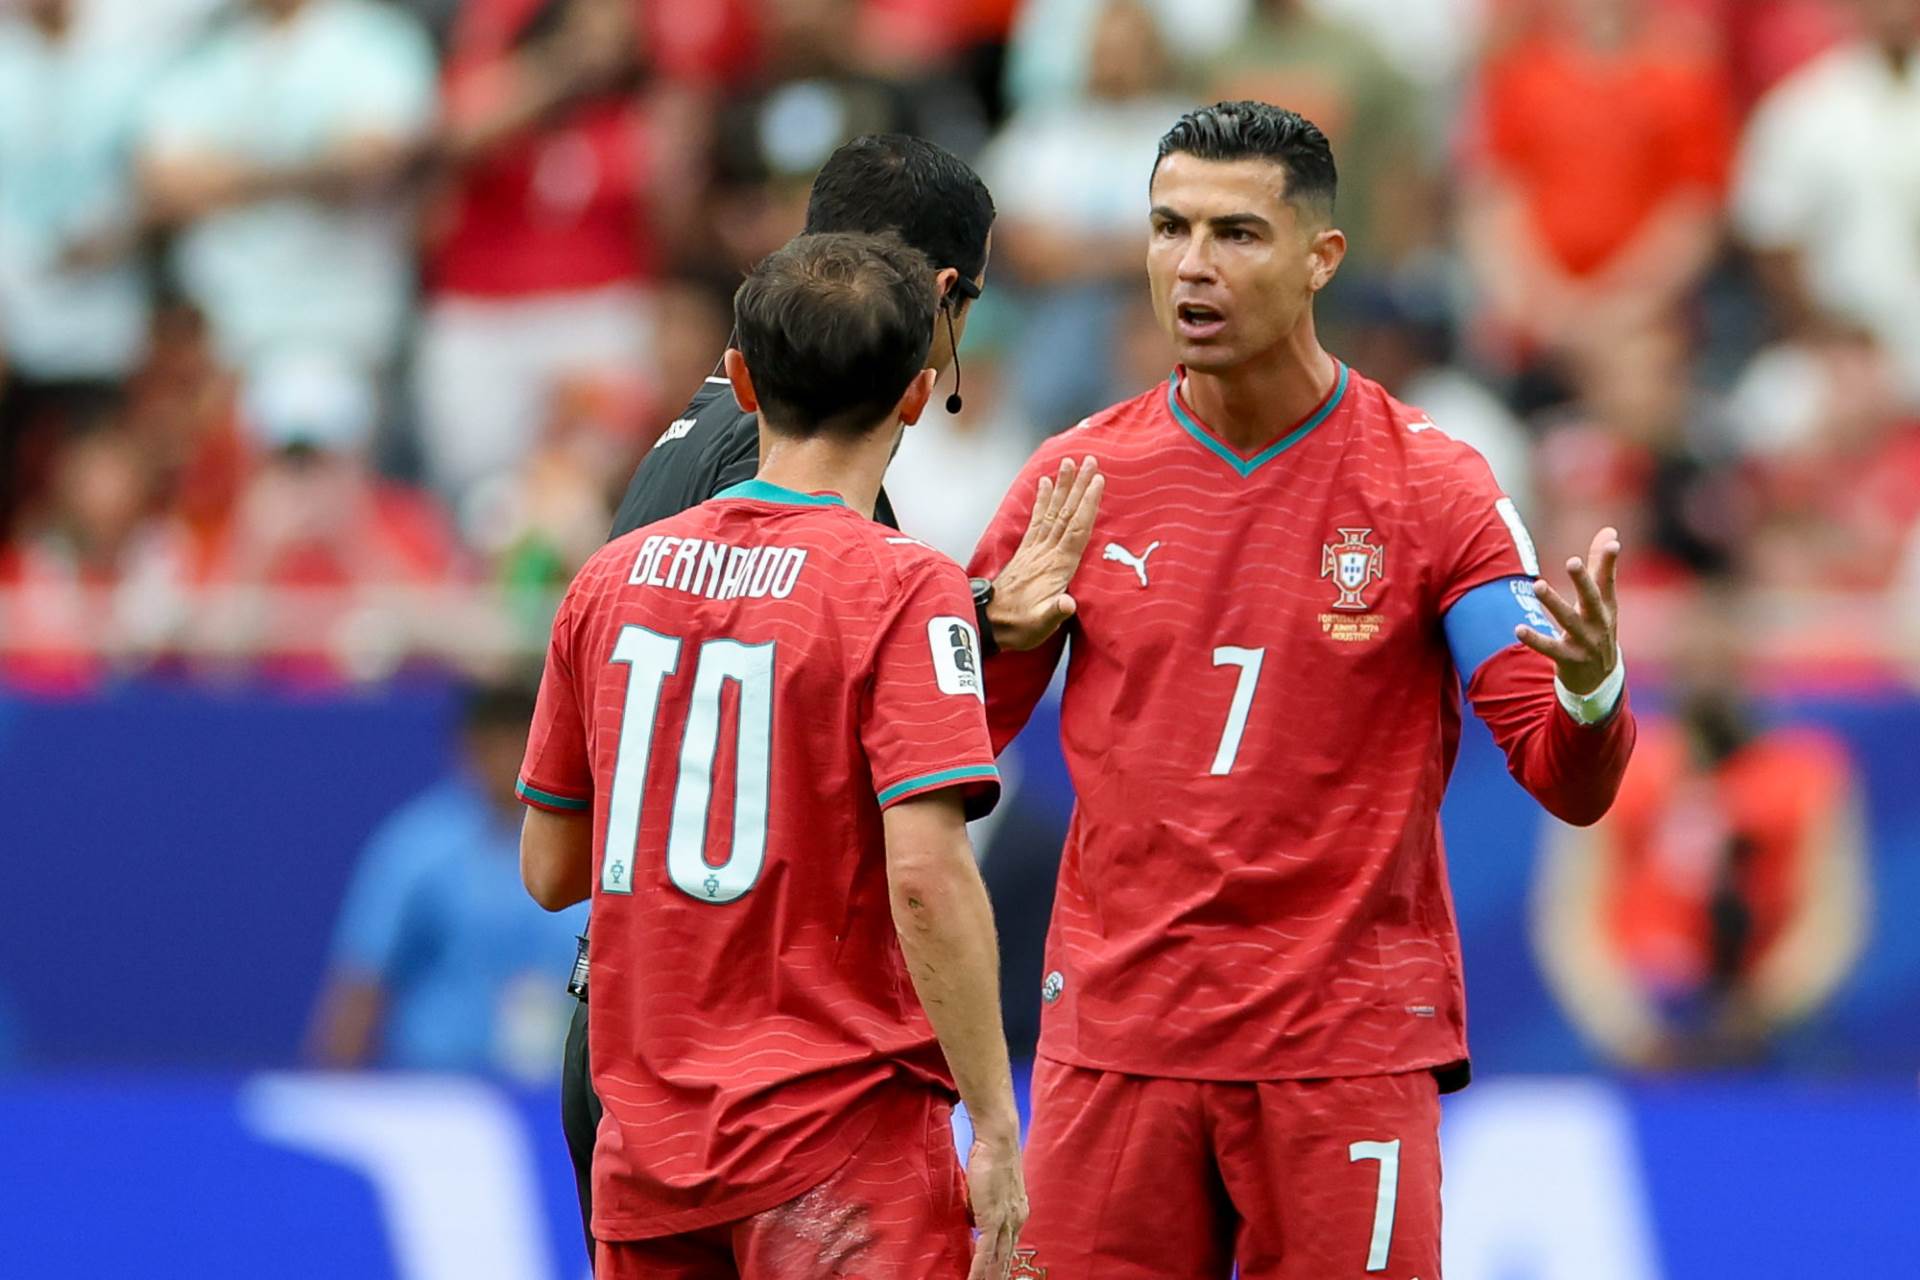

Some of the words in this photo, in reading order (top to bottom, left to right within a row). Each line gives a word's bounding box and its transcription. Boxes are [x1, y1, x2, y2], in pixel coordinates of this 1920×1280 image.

[628, 535, 808, 600] BERNARDO
[600, 624, 776, 905] 10
[1212, 646, 1265, 776] 7
[1349, 1138, 1401, 1272] 7
